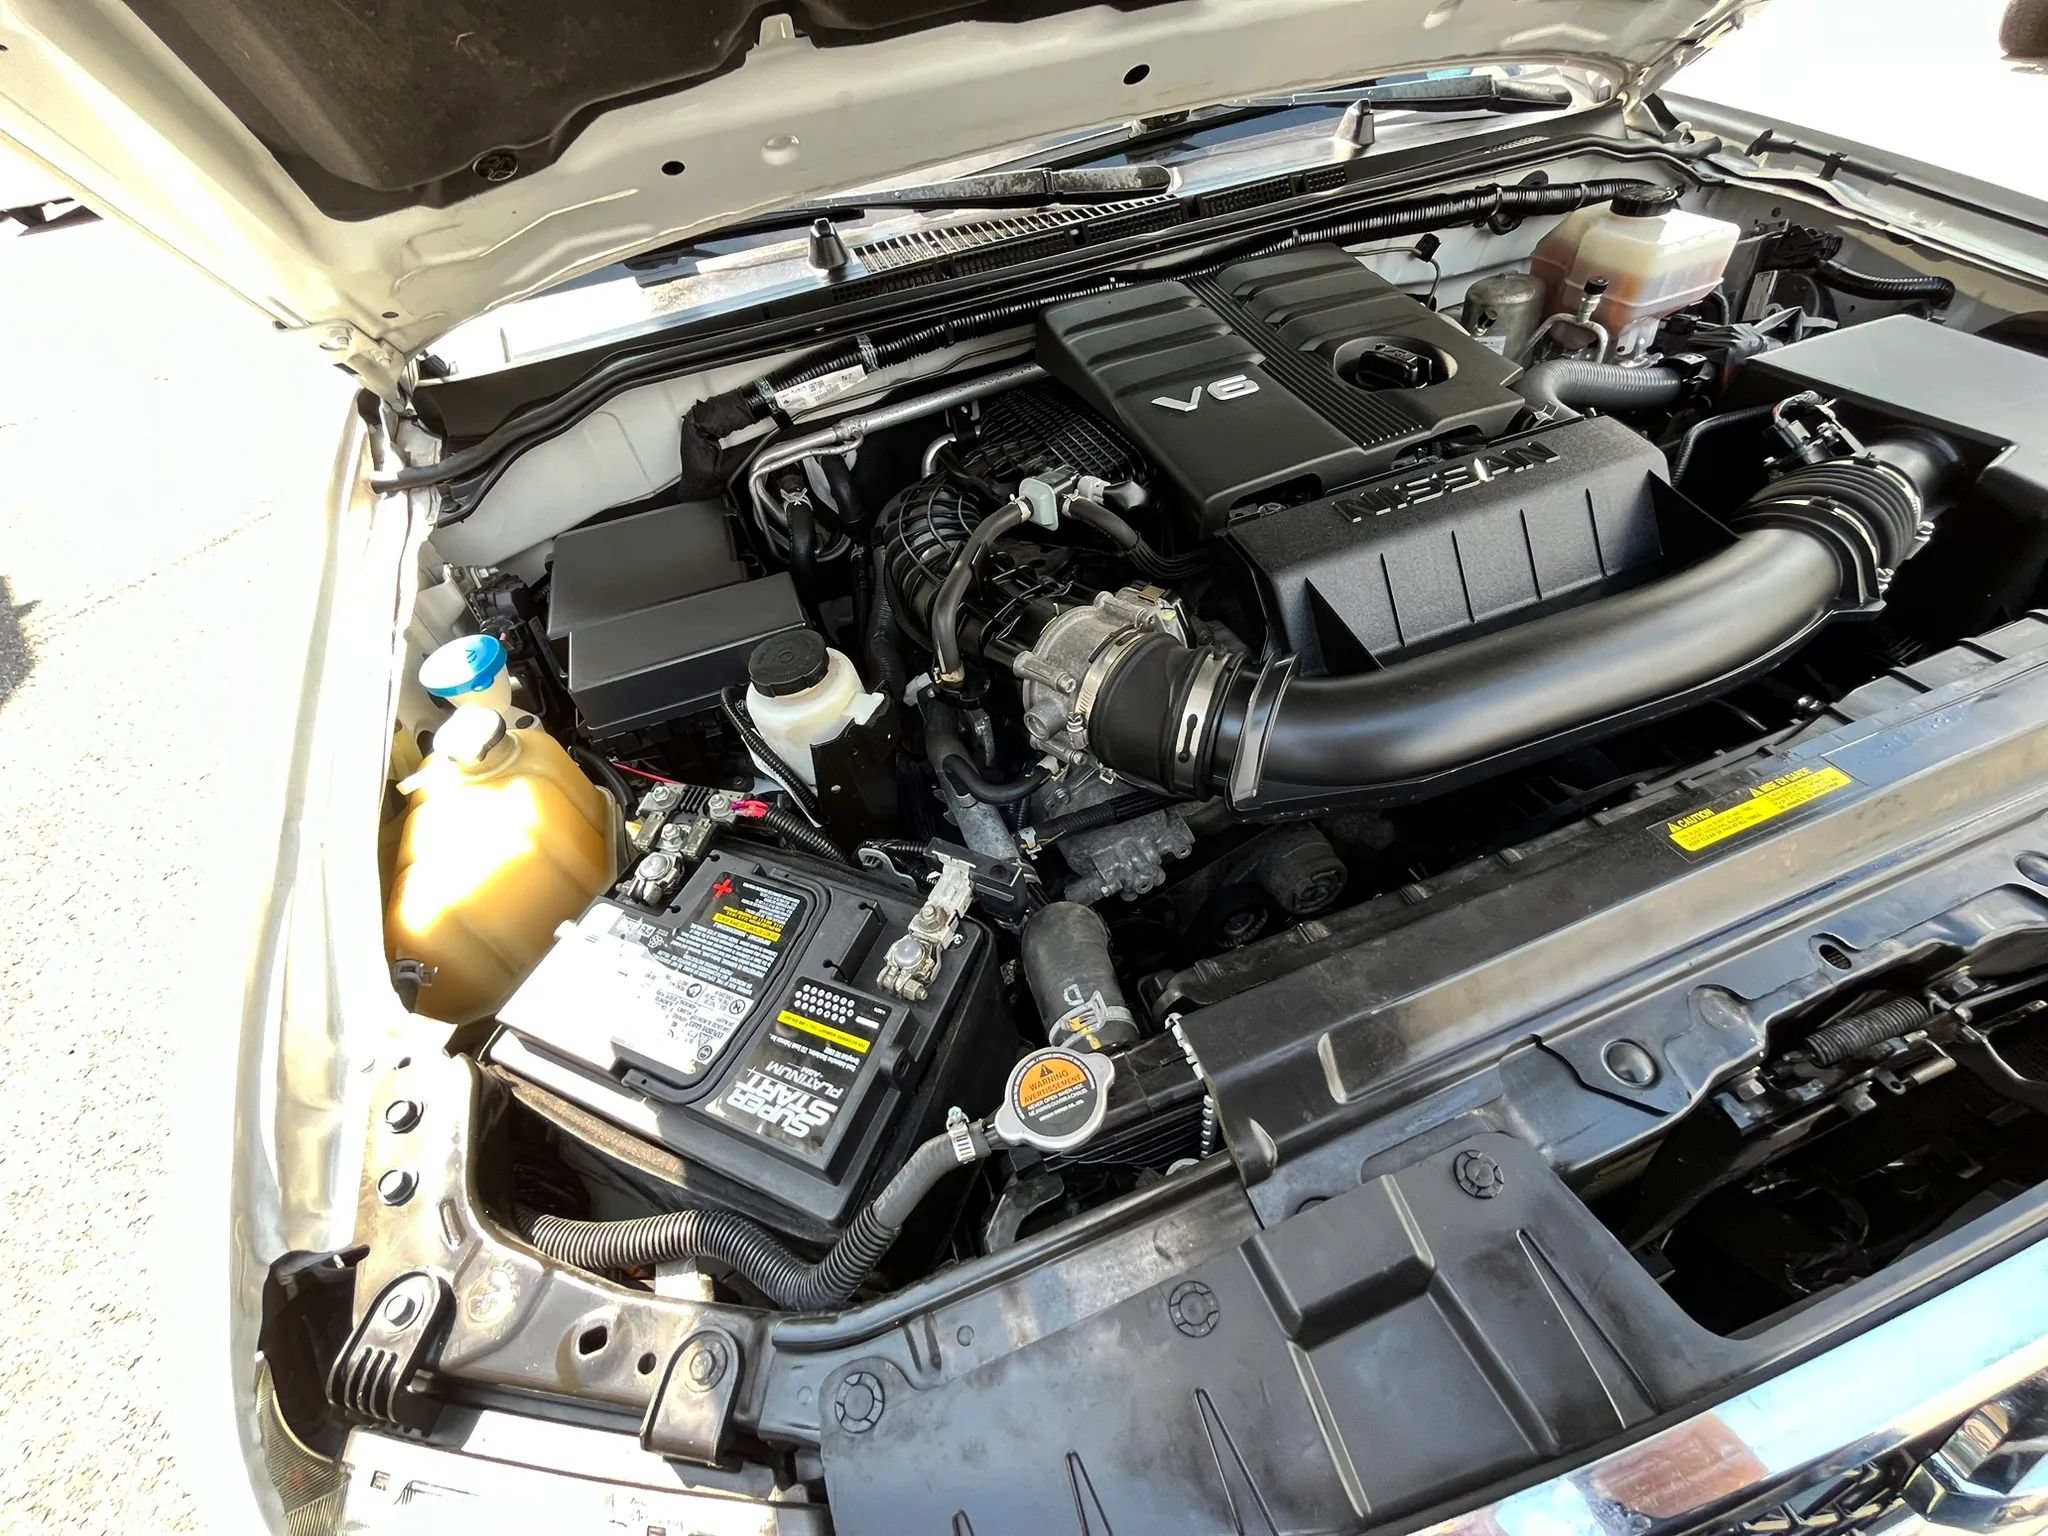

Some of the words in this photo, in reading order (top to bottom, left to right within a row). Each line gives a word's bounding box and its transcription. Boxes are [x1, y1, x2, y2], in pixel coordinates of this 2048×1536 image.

[1151, 374, 1260, 412] V6
[1331, 440, 1562, 523] NISSAN
[1757, 779, 1779, 793] MISE
[1774, 776, 1789, 786] EN
[1677, 807, 1715, 828] CAUTION
[701, 1025, 723, 1038] EXPLOSIVE
[765, 1060, 843, 1098] PLATINUM
[1023, 1074, 1081, 1103] AVERTISSEMENT
[1029, 1070, 1068, 1090] WARNING
[728, 1087, 816, 1137] SUPER
[735, 1075, 838, 1125] START
[1027, 1098, 1045, 1110] NEVER
[1045, 1093, 1057, 1103] OPEN
[1058, 1086, 1073, 1097] WHEN
